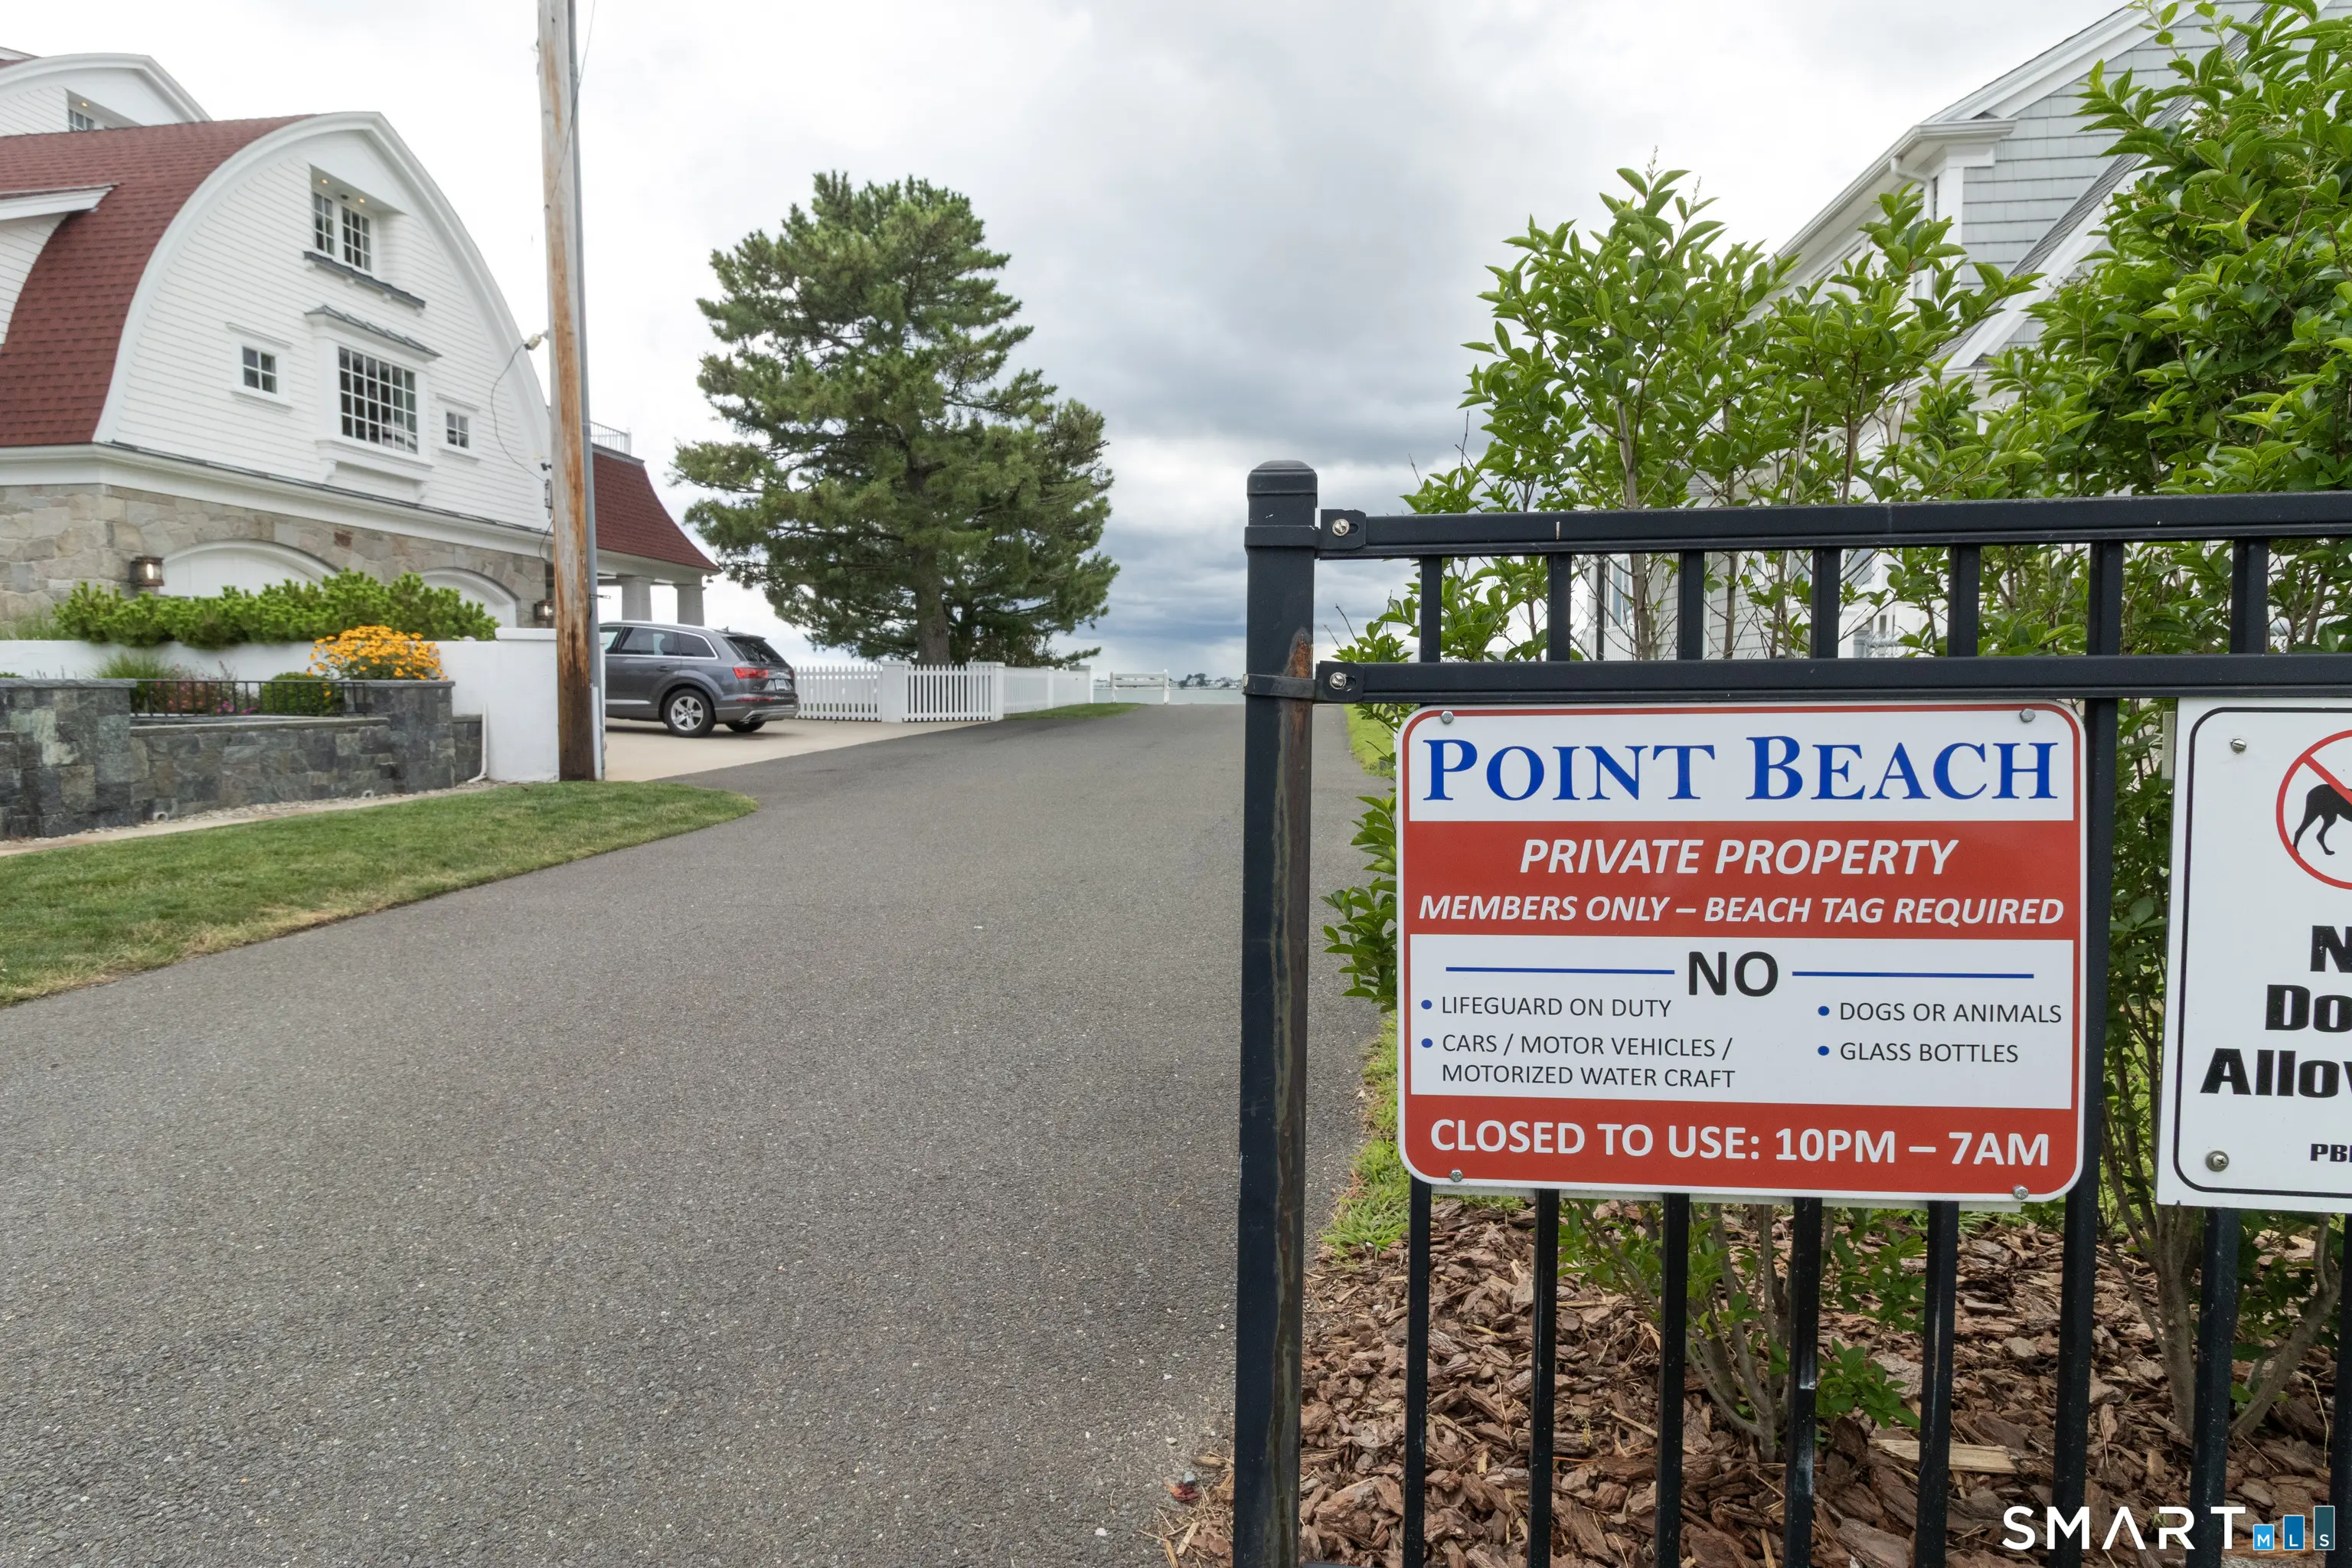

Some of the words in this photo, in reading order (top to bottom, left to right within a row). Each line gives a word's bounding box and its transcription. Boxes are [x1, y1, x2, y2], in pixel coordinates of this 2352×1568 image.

[1423, 739, 1716, 802] POINT
[1746, 735, 2059, 801] BEACH
[1520, 839, 1704, 874] PRIVATE
[1715, 839, 1959, 875] PROPERTY
[1419, 895, 1578, 921] MEMBERS
[1586, 896, 1671, 921] ONLY
[1704, 897, 1812, 923] BEACH
[1821, 897, 1885, 923] TAG
[1893, 898, 2064, 928] REQUIRED
[1688, 951, 1779, 998] NO
[1442, 996, 1563, 1015] LIFEGUARD
[1570, 998, 1603, 1017] ON
[1612, 998, 1671, 1018] DUTY
[1840, 1002, 1906, 1021] DOGS
[1913, 1003, 1946, 1022] OR
[1953, 1004, 2062, 1024] ANIMALS
[1442, 1034, 1498, 1053] CARS
[1521, 1035, 1604, 1055] MOTOR
[1611, 1037, 1716, 1057] VEHICLES
[1840, 1042, 1911, 1061] GLASS
[1919, 1044, 2018, 1063] BOTTLES
[1442, 1064, 1573, 1084] MOTORIZED
[1579, 1067, 1657, 1086] WATER
[1664, 1069, 1736, 1088] CRAFT
[2200, 1047, 2352, 1099] Allo
[1431, 1119, 1586, 1154] CLOSED
[1596, 1123, 1654, 1157] TO
[1668, 1125, 1759, 1160] USE:
[1775, 1128, 1895, 1163] 10PM
[1949, 1132, 2049, 1166] 7AM
[2310, 1143, 2352, 1163] PB
